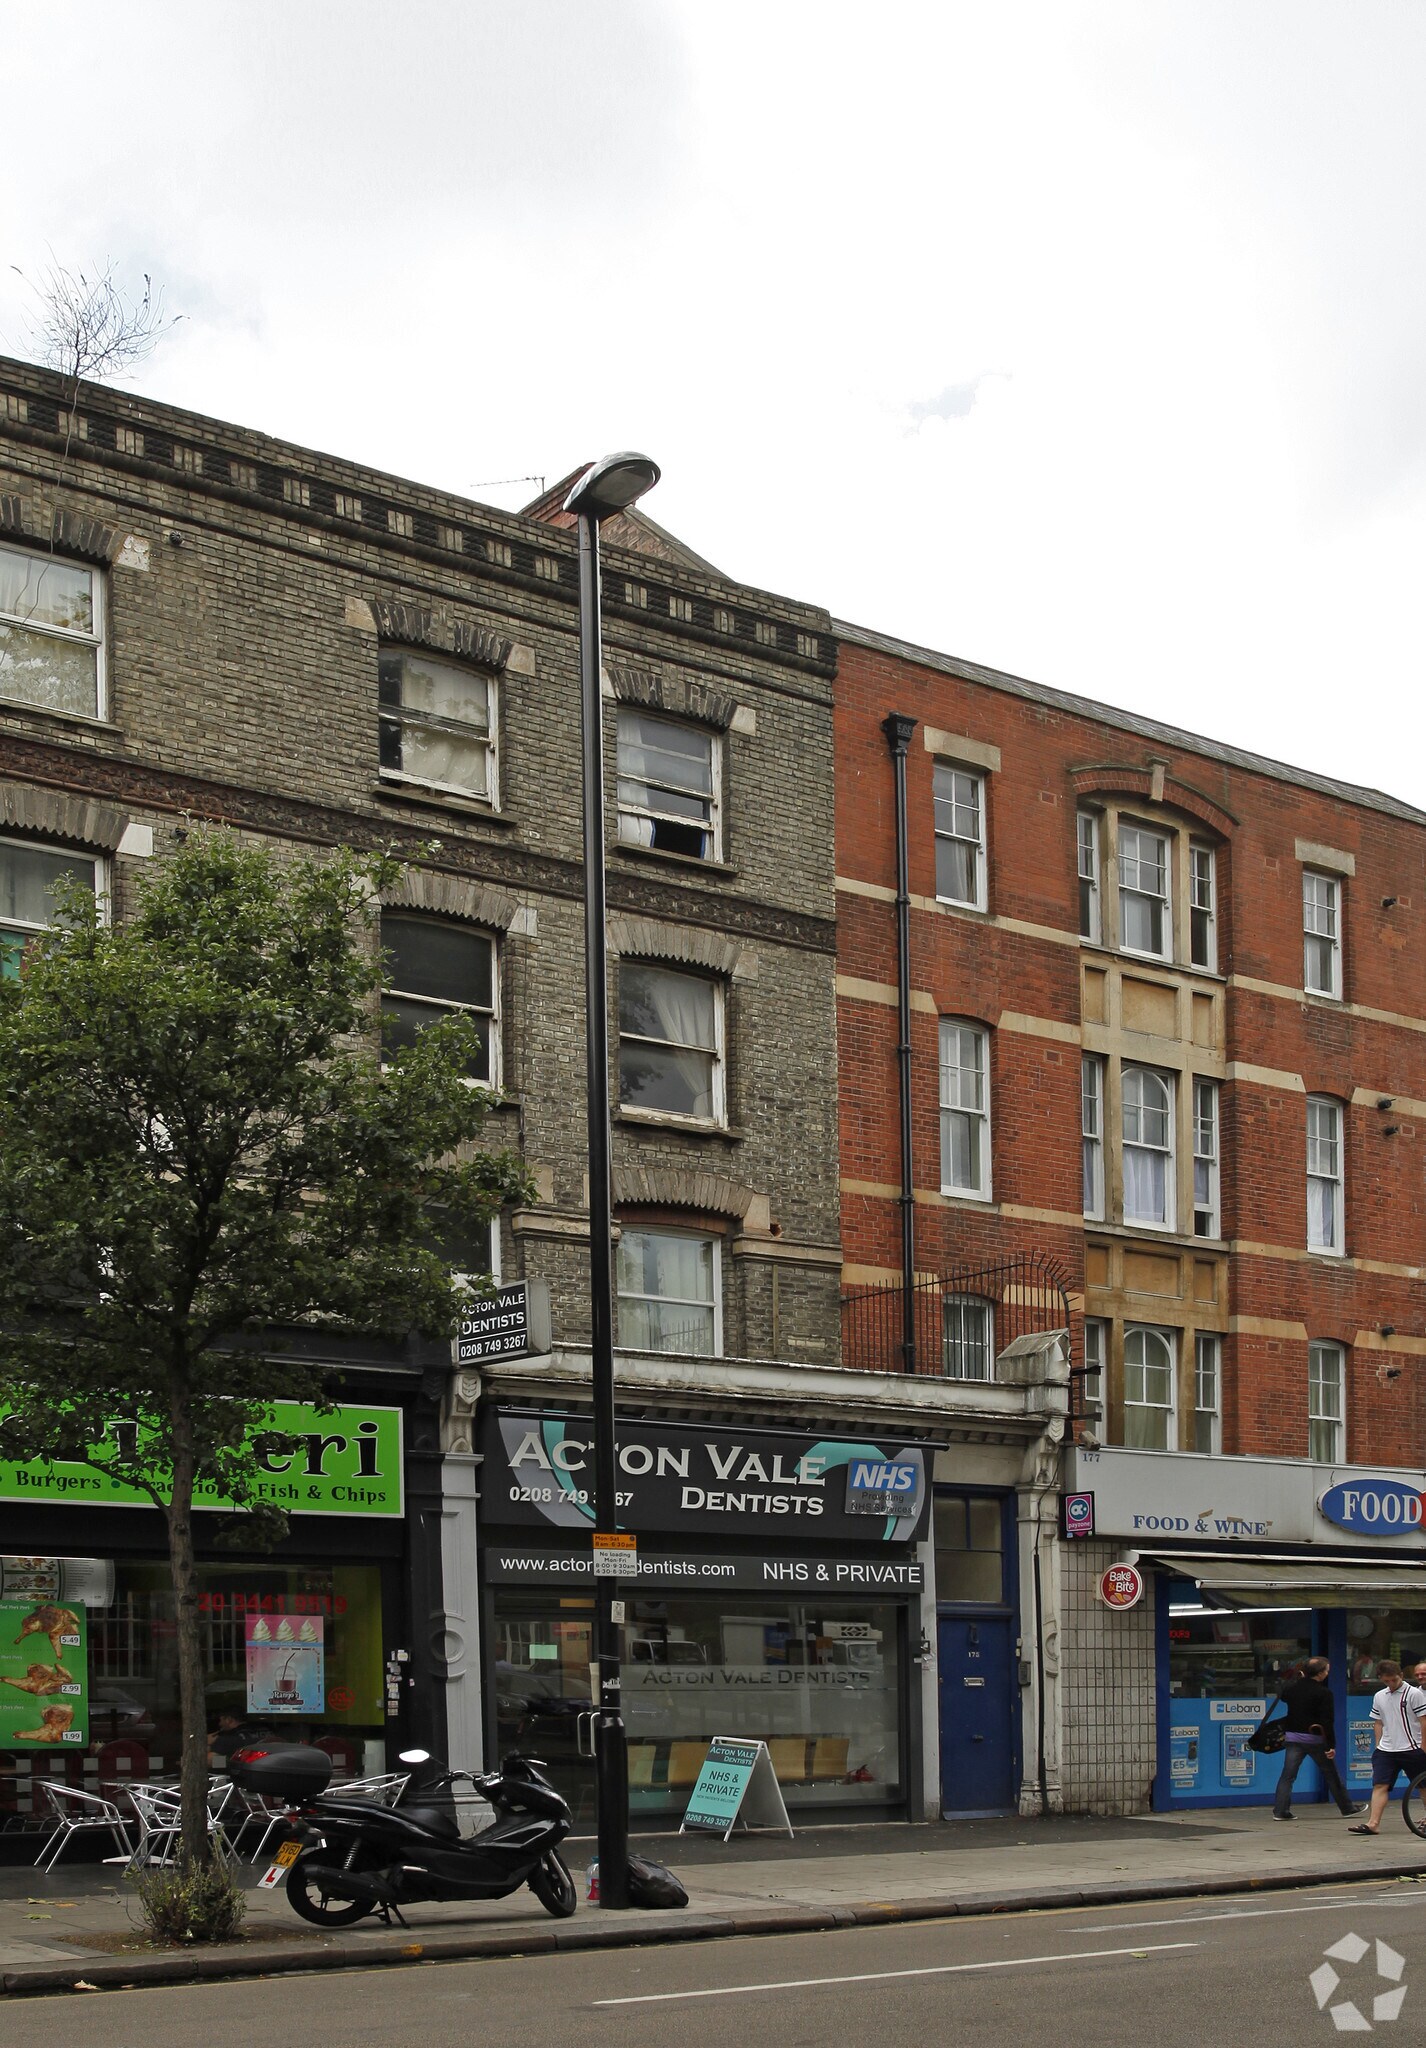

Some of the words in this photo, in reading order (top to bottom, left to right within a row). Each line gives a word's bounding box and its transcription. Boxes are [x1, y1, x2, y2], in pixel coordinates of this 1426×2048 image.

[461, 1301, 496, 1314] ACTON
[499, 1293, 525, 1308] VALE
[462, 1312, 525, 1335] DENTISTS
[460, 1343, 483, 1358] 0208
[484, 1339, 501, 1353] 749
[503, 1334, 526, 1350] 3267
[704, 1443, 827, 1486] VALE
[1083, 1453, 1100, 1462] 177
[15, 1470, 102, 1492] Burgers
[853, 1463, 915, 1490] NHS
[258, 1483, 299, 1499] Fish
[306, 1485, 323, 1500] &
[331, 1486, 386, 1505] Chips
[509, 1486, 552, 1503] 0208
[557, 1489, 589, 1505] 749
[592, 1489, 634, 1507] 67
[680, 1485, 825, 1516] DENTISTS
[862, 1491, 904, 1503] Providing
[850, 1503, 872, 1511] NHS
[874, 1504, 912, 1513] Services
[1342, 1490, 1423, 1524] FOOD
[1068, 1520, 1091, 1529] payzone
[1133, 1515, 1190, 1532] FOOD
[1194, 1518, 1209, 1534] &
[1214, 1519, 1267, 1536] WINE
[763, 1562, 809, 1581] NHS
[815, 1564, 830, 1581] &
[837, 1564, 921, 1584] PRIVATE
[1109, 1570, 1132, 1582] Bake
[1108, 1584, 1115, 1592] &
[1115, 1581, 1135, 1593] Bite
[234, 1592, 285, 1612] 3441
[294, 1593, 348, 1614] 9519
[61, 1636, 79, 1644] 5.49
[642, 1669, 714, 1684] ACTON
[720, 1670, 771, 1684] VALE
[777, 1670, 870, 1684] DENTISTS
[1225, 1703, 1261, 1714] Lebara
[1174, 1729, 1200, 1737] Lebara
[710, 1746, 735, 1756] ACTON
[737, 1750, 755, 1759] VALE
[724, 1756, 753, 1765] DENTISTS
[1173, 1760, 1185, 1769] £5
[709, 1770, 730, 1782] NHS
[731, 1773, 739, 1783] &
[699, 1782, 741, 1797] PRIVATE
[685, 1814, 702, 1823] 0208
[702, 1816, 714, 1825] 749
[715, 1818, 730, 1826] 3267
[265, 1868, 277, 1883] L
